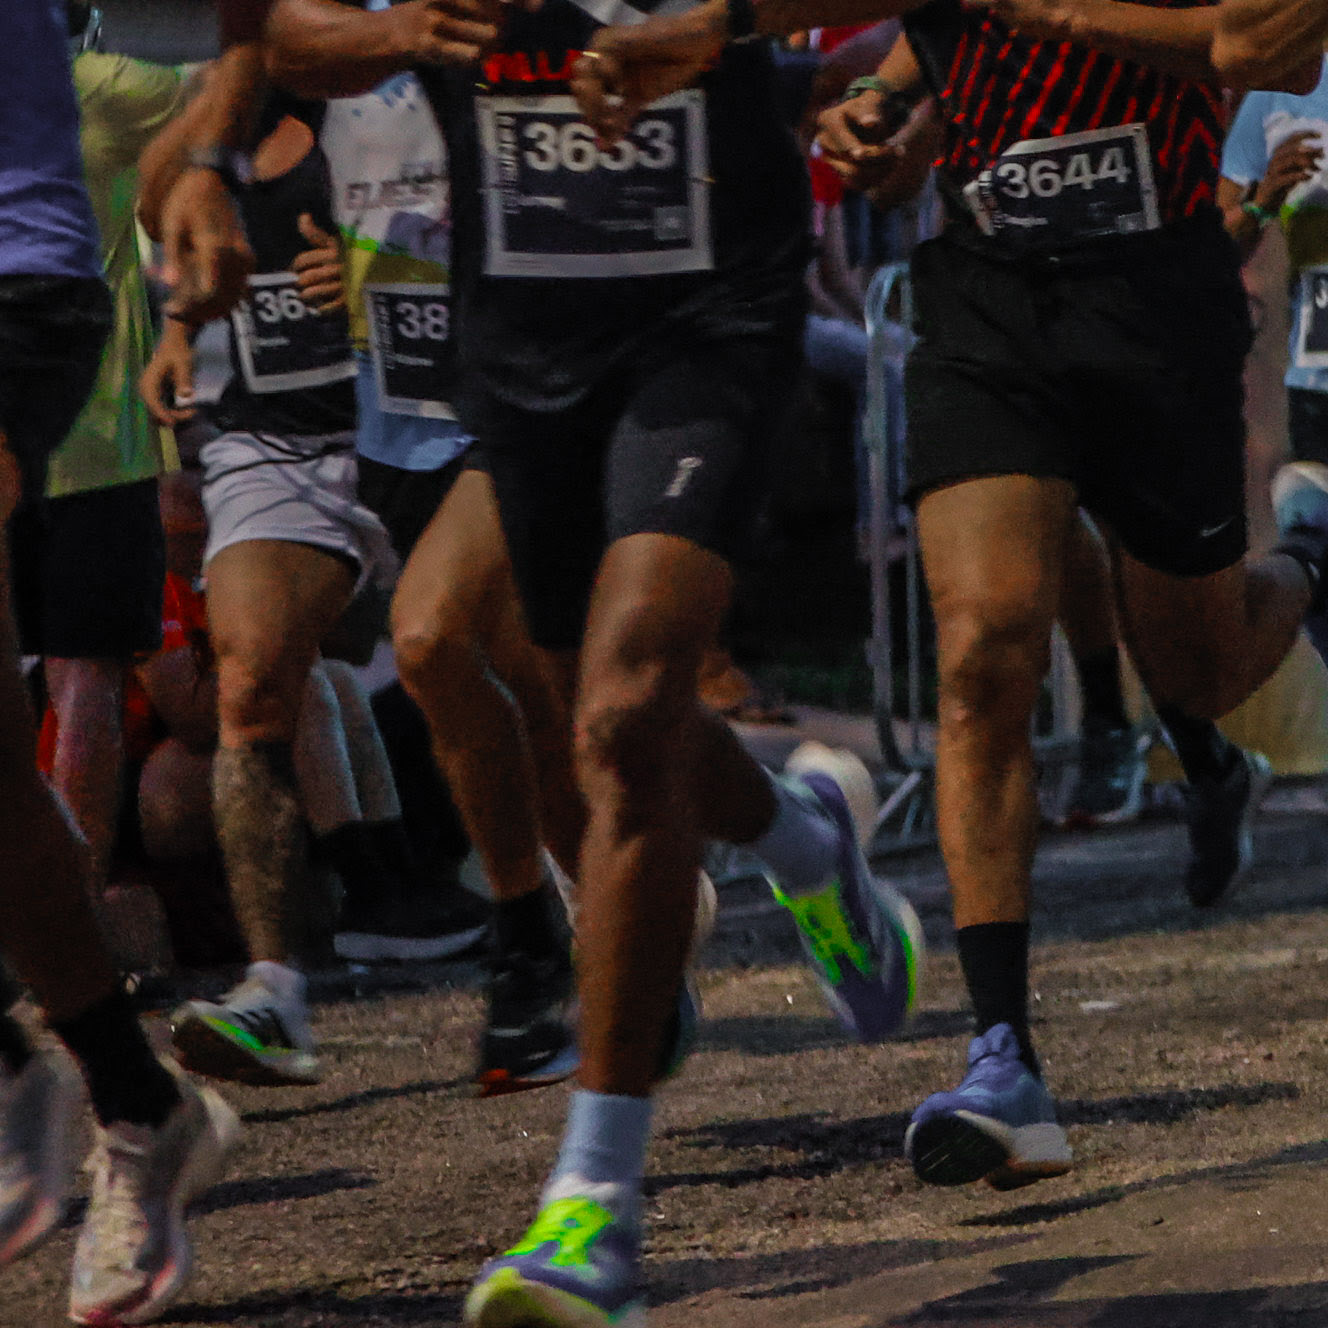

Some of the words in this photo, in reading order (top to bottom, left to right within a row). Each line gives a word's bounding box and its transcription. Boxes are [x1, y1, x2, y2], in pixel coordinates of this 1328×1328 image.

[996, 146, 1131, 200] 3644
[254, 286, 320, 323] 36
[396, 301, 451, 341] 38
